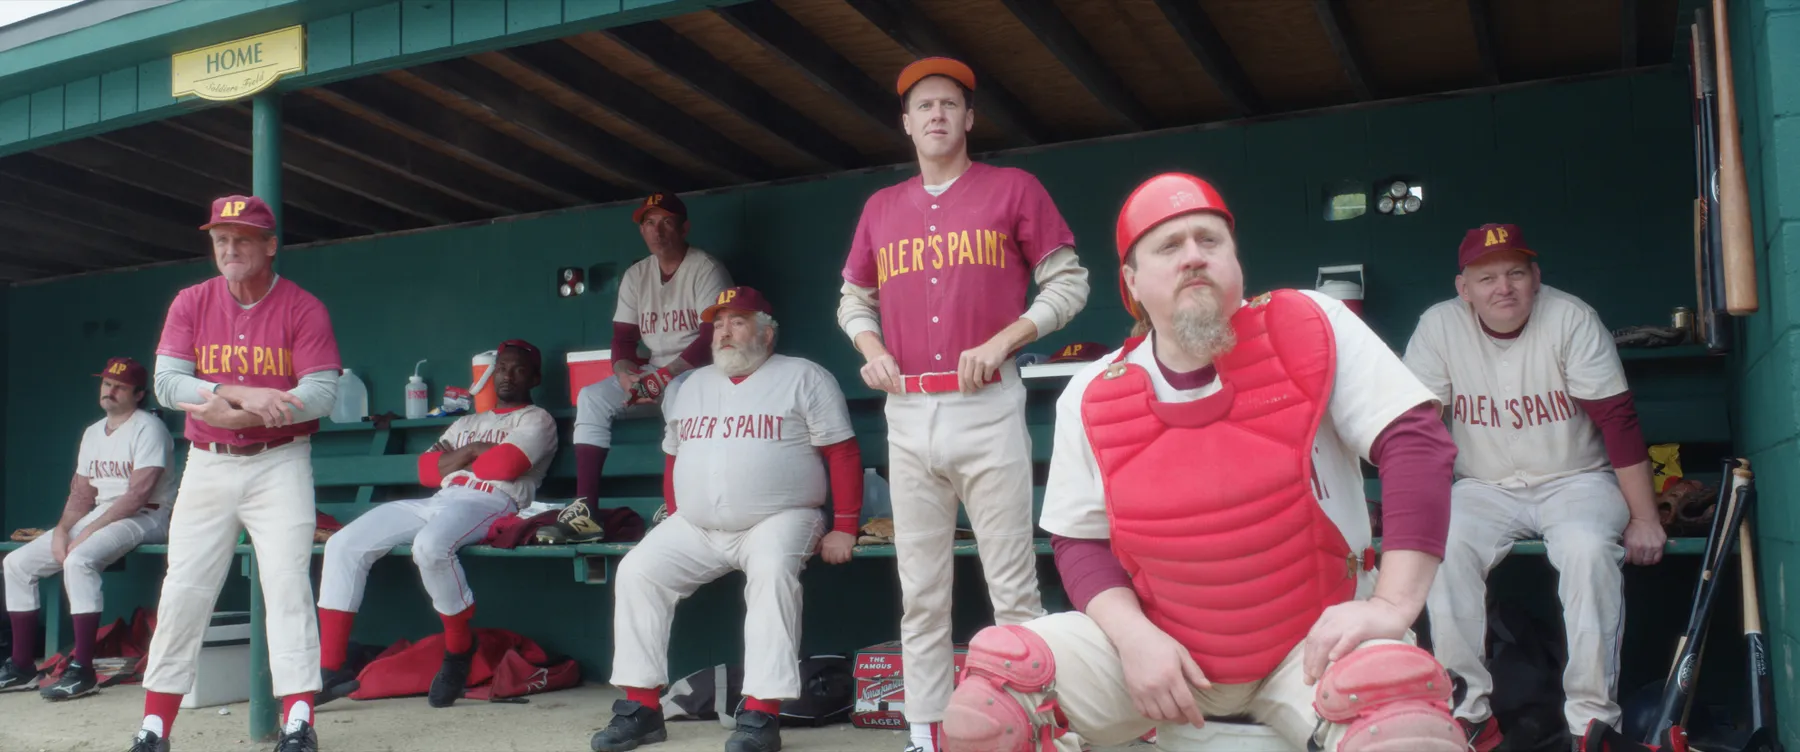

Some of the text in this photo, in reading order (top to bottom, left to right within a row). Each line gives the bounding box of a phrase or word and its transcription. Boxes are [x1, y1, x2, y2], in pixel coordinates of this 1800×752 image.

[206, 42, 263, 74] HOME
[205, 70, 265, 93] Soldiers Field
[647, 193, 664, 206] AP
[220, 201, 246, 217] AP
[1484, 227, 1509, 247] AP
[877, 229, 1007, 290] ADLER'S PAINT
[717, 289, 737, 305] AP
[1062, 344, 1083, 357] AP
[108, 362, 127, 375] AP
[735, 414, 784, 441] PAINT
[862, 717, 901, 726] LAGER
